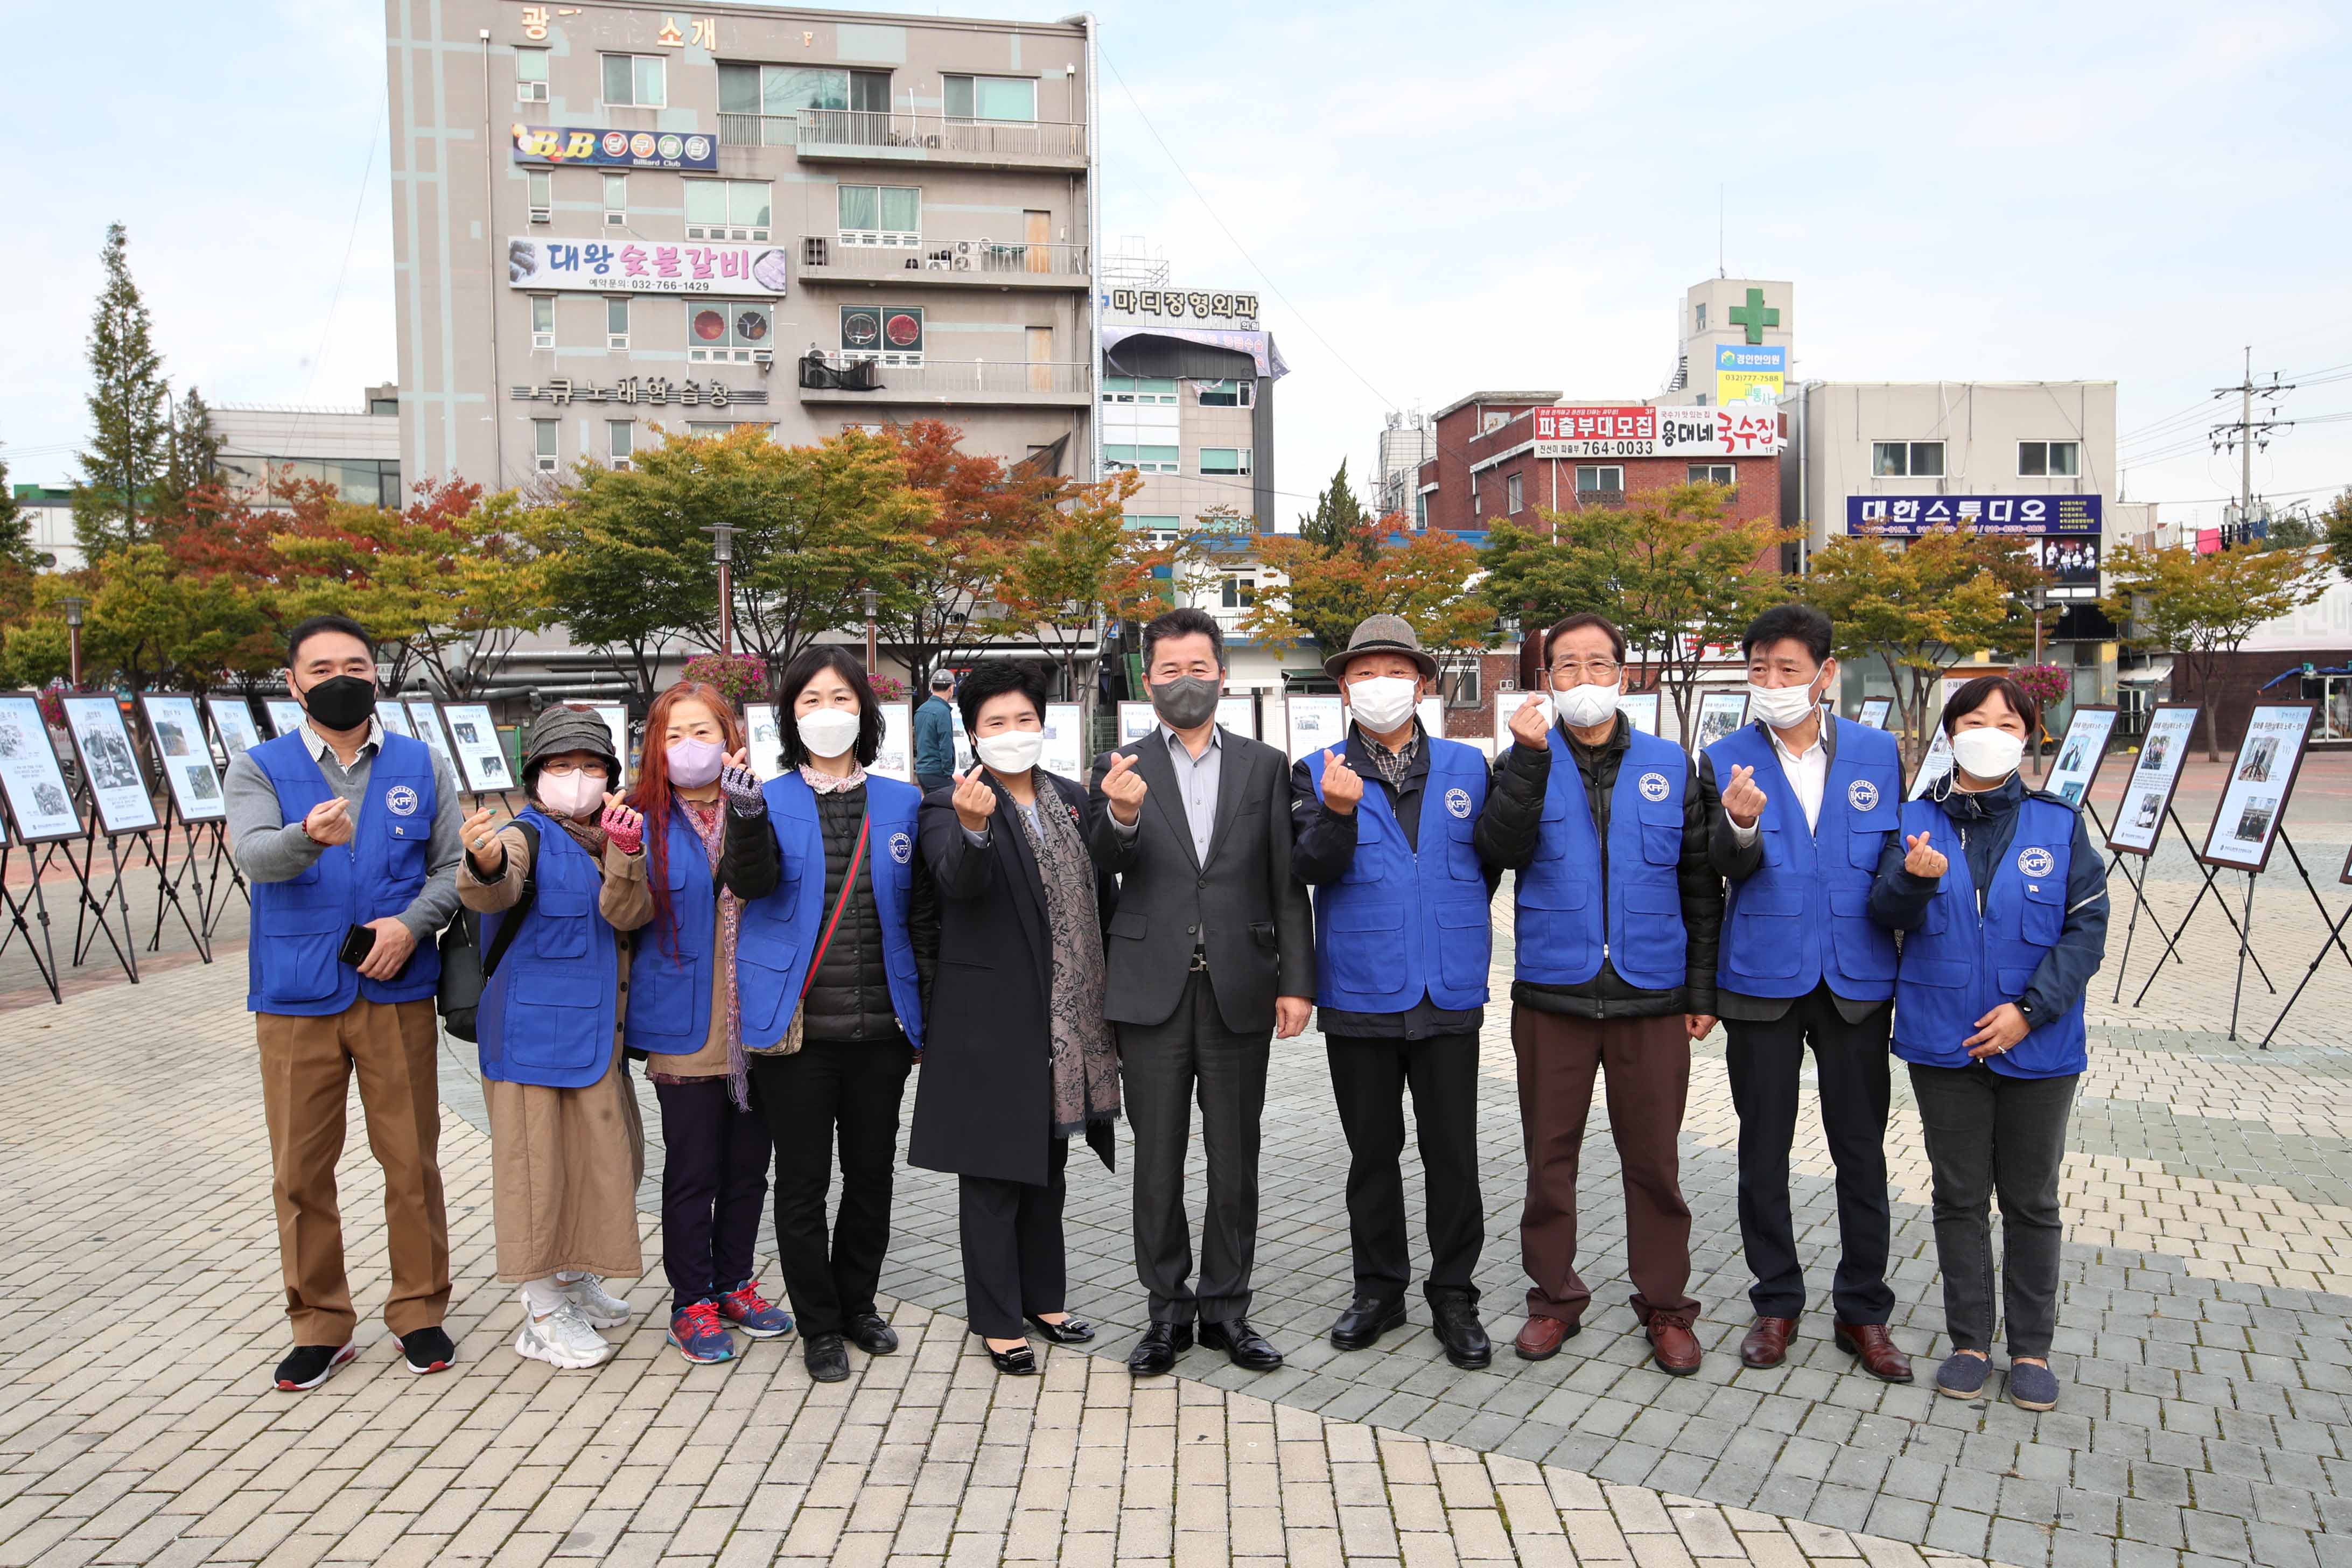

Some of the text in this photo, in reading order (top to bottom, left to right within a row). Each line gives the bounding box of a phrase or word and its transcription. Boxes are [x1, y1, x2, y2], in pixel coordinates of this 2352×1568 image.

[633, 158, 681, 167] Billiard Club
[547, 243, 614, 275] 대왕
[632, 280, 710, 291] 032-766-1429
[1113, 289, 1259, 319] 마디정형외과
[1736, 354, 1780, 365] 경인한의원
[1661, 411, 1680, 419] 국수가
[1538, 416, 1653, 438] 파출부대모집
[1662, 412, 1775, 453] 용대네 국수집
[1540, 441, 1653, 455] 진선미 파출부 764-0033
[1861, 500, 2046, 522] 대한스튜디오
[1646, 783, 1663, 792] KFF
[393, 796, 412, 806] KFF
[1855, 791, 1873, 801] KFF
[2025, 858, 2047, 867] KFF
